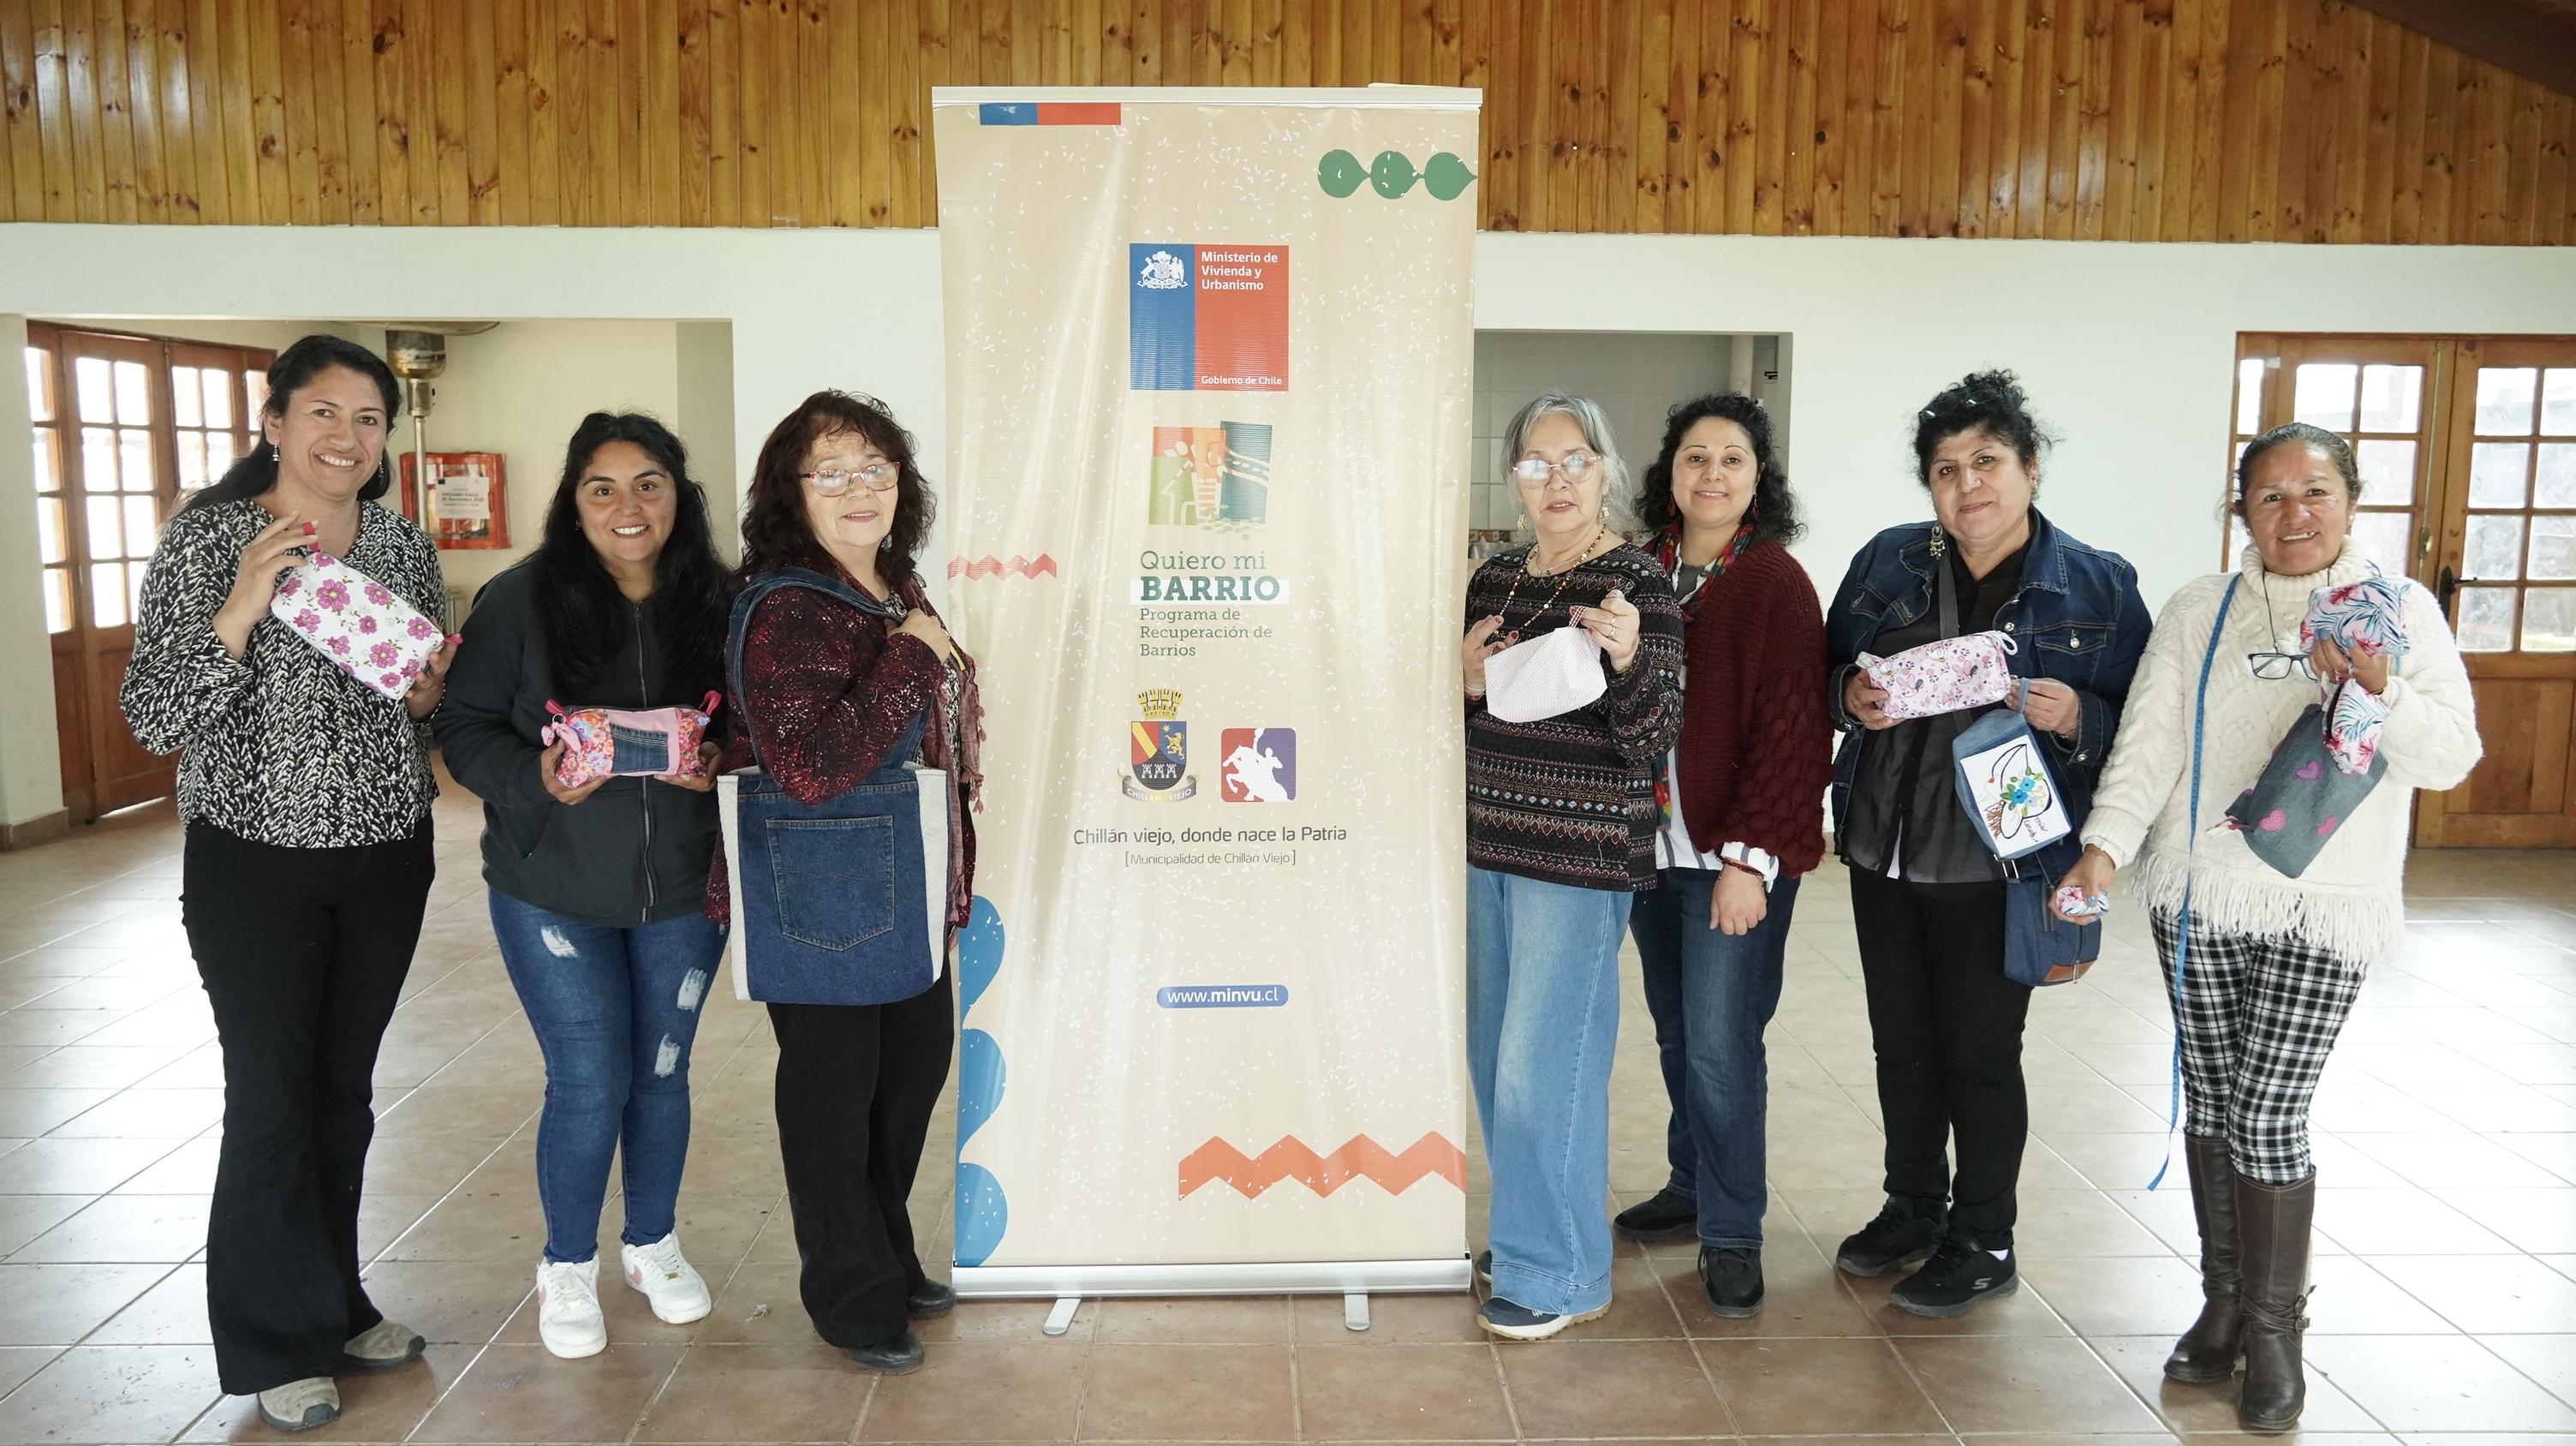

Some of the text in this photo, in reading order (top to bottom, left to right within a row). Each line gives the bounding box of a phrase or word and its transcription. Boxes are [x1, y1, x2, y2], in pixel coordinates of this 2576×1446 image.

[1201, 251, 1279, 264] Ministerio de
[1201, 265, 1262, 279] Vivienda y
[1201, 278, 1264, 290] Urbanismo
[1201, 375, 1283, 385] Gobierno de Chile
[1140, 550, 1267, 570] Quiero mi
[1140, 575, 1280, 601] BARRIO
[1140, 607, 1241, 624] Programa de
[1140, 625, 1273, 641] Recuperación de
[1140, 643, 1196, 656] Barrios
[1168, 788, 1192, 802] VIEJO
[1073, 825, 1347, 846] Chillán viejo, donde nace la Patria
[1208, 853, 1221, 864] de
[1225, 852, 1260, 863] Chillán
[1166, 986, 1279, 1003] www.minvu.cl
